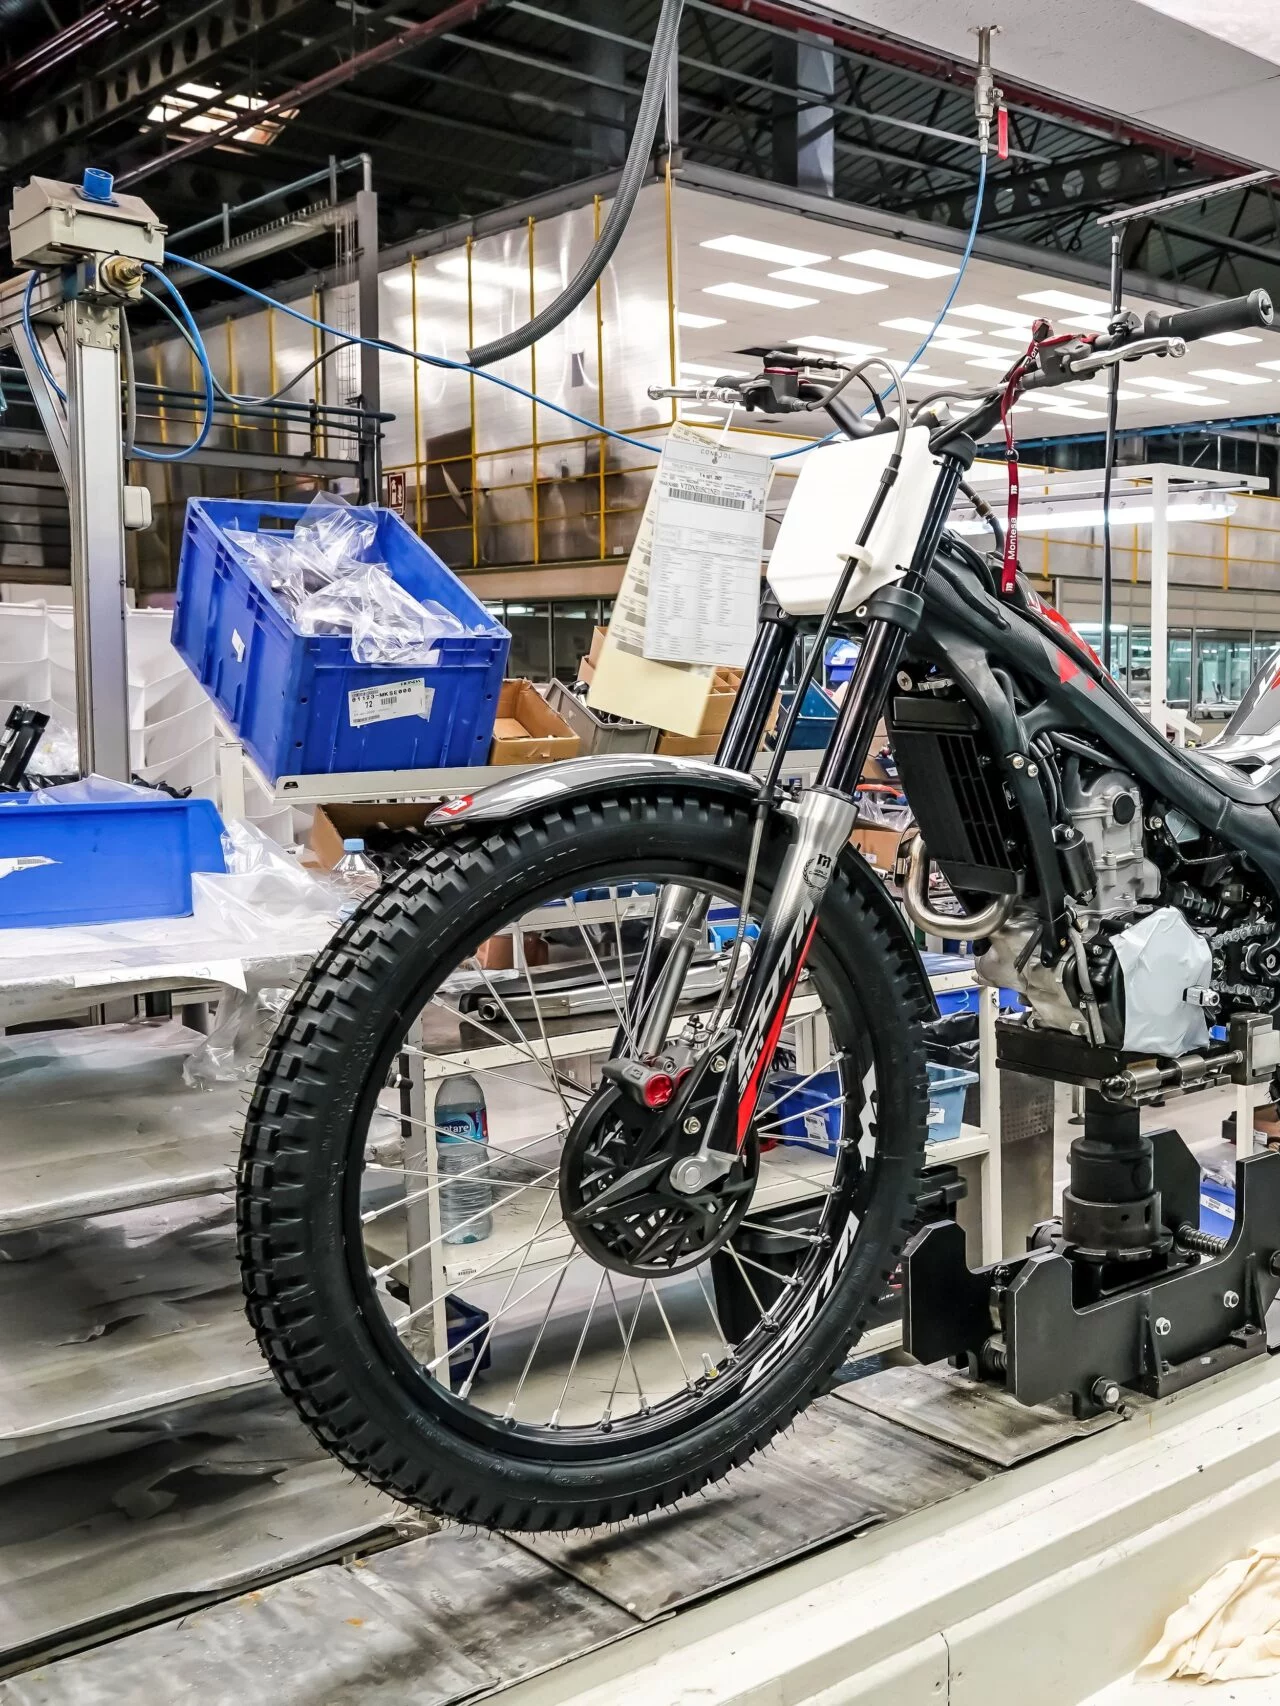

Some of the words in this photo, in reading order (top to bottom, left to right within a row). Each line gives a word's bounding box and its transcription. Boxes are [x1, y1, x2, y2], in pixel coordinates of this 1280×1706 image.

[1008, 517, 1018, 560] Montesa
[365, 700, 373, 709] 72
[739, 897, 815, 1086] COTA
[740, 1210, 860, 1395] COTA
